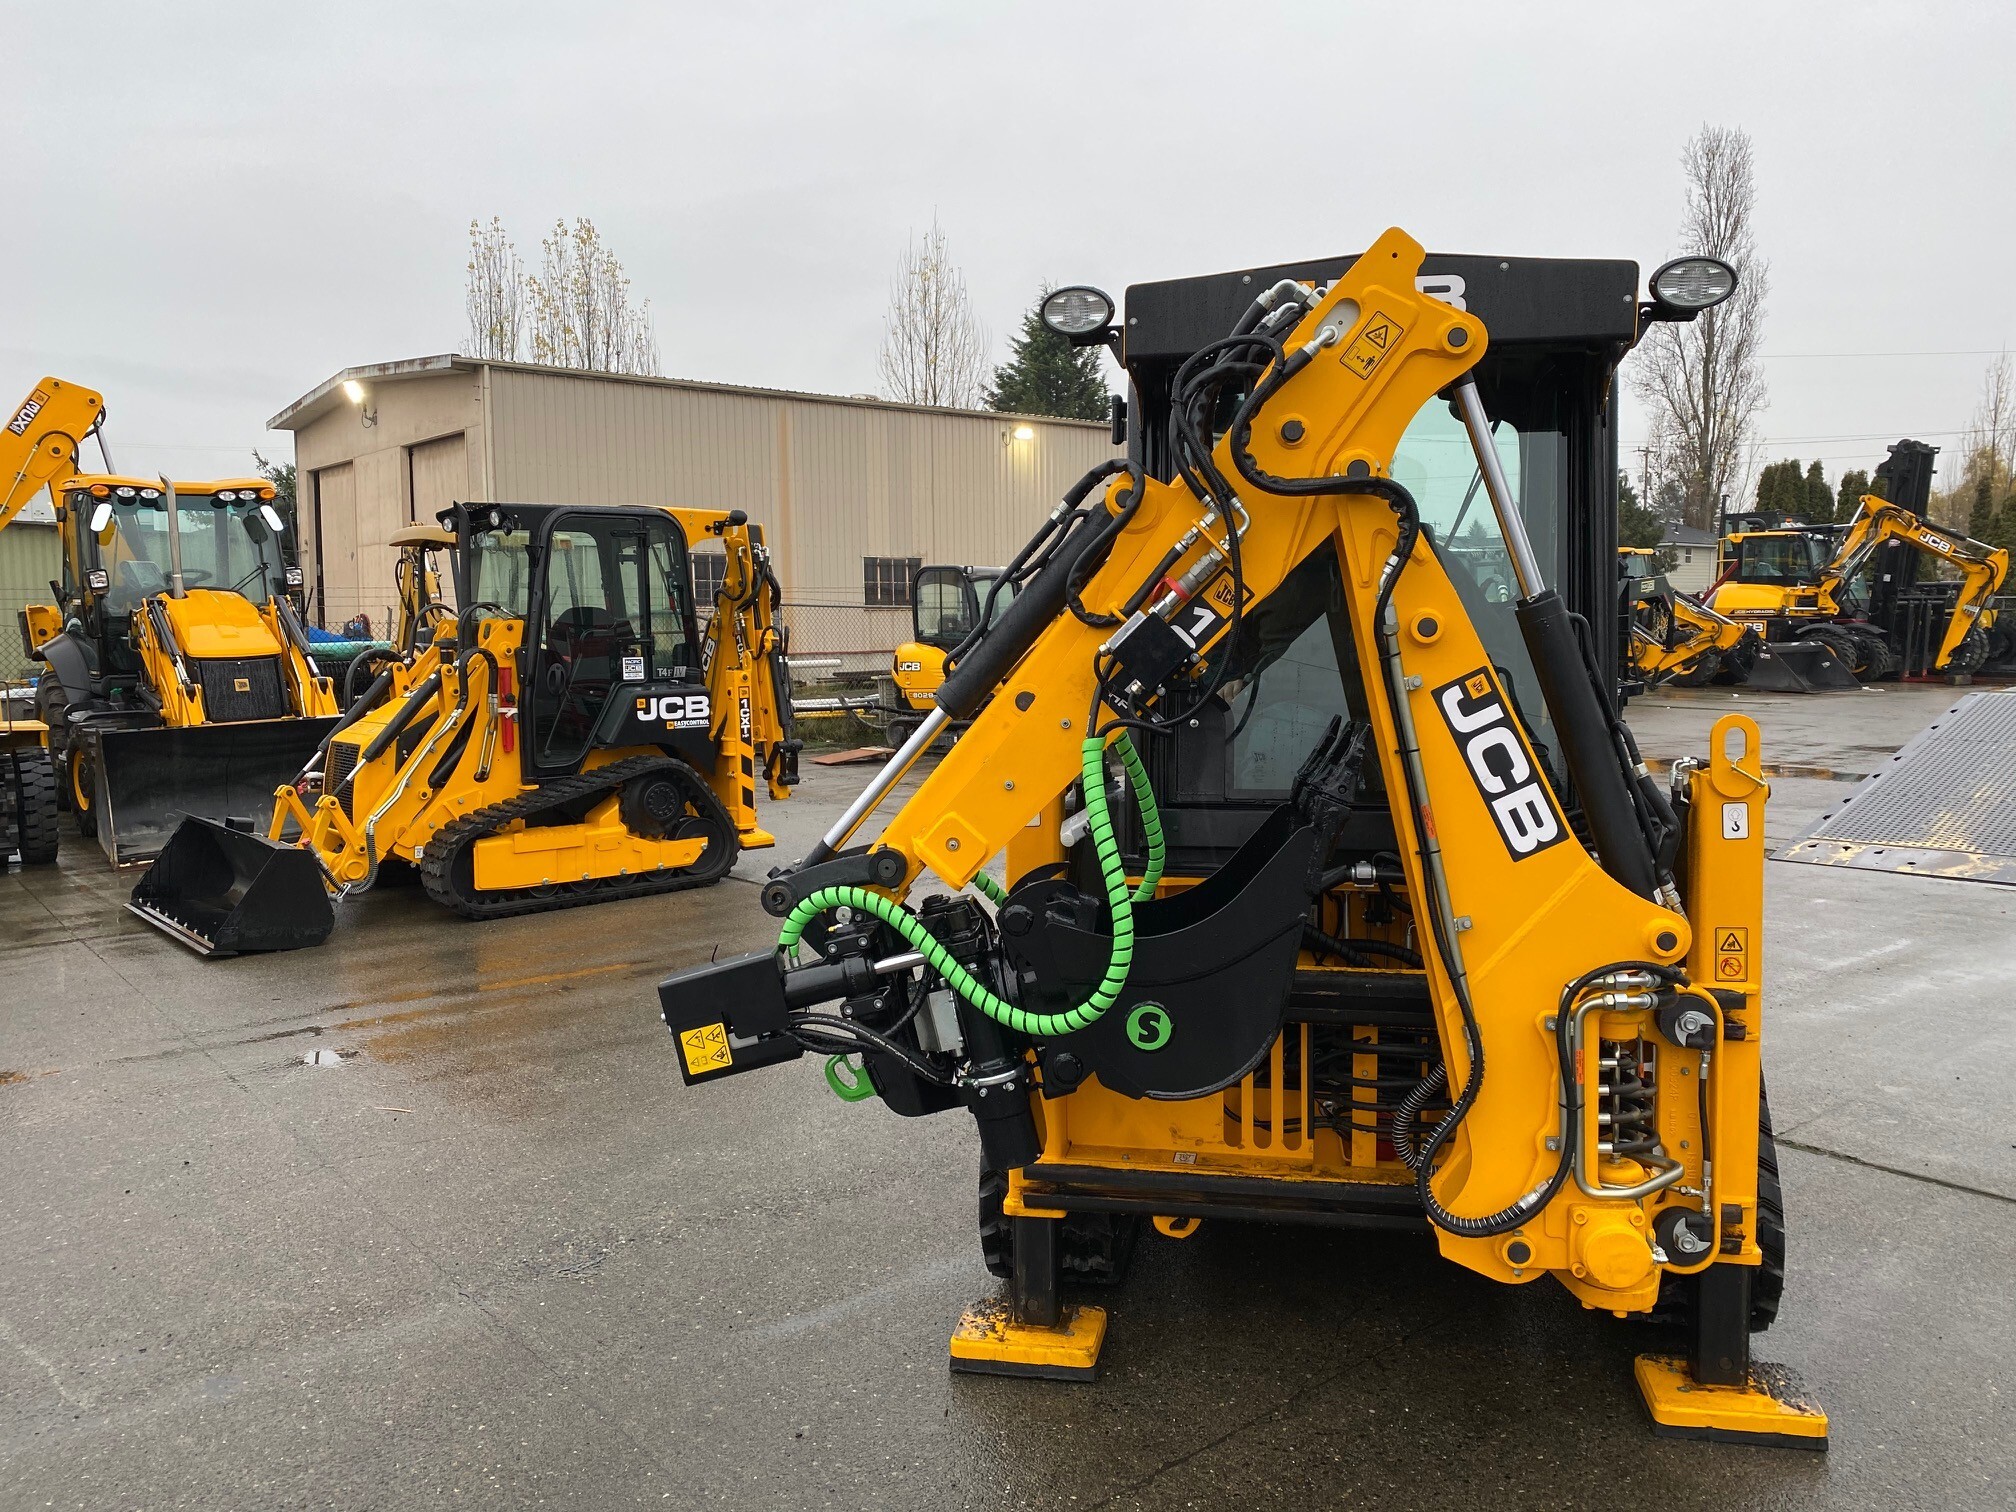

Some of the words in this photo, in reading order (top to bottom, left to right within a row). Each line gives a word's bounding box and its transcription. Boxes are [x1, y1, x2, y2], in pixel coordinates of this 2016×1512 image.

[1919, 533, 1951, 553] JCB
[900, 662, 921, 671] JCB
[636, 695, 710, 722] JCB
[1441, 684, 1559, 853] JCB
